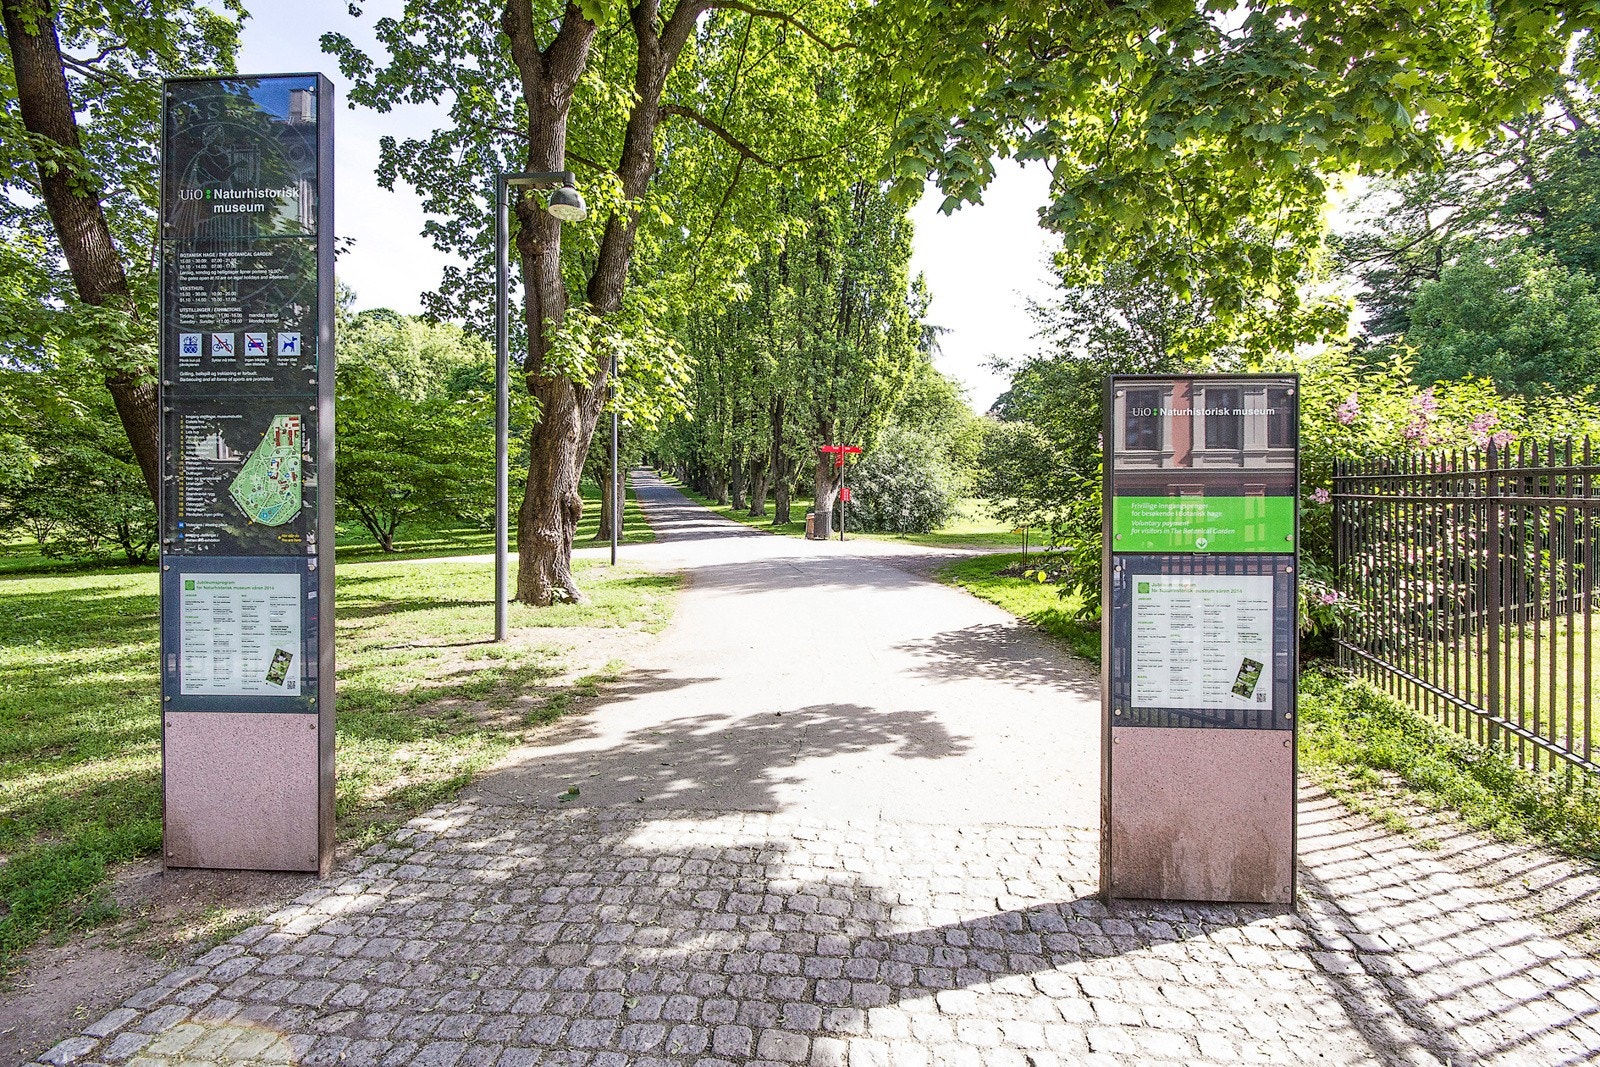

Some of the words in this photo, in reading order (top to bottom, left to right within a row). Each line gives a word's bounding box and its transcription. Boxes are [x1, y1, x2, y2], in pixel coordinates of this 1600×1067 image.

[180, 190, 203, 200] UiO
[214, 188, 299, 199] Naturhistorisk
[214, 204, 265, 213] museum
[1132, 408, 1152, 416] UiO
[1160, 408, 1230, 416] Naturhistorisk
[1233, 408, 1275, 416] museum
